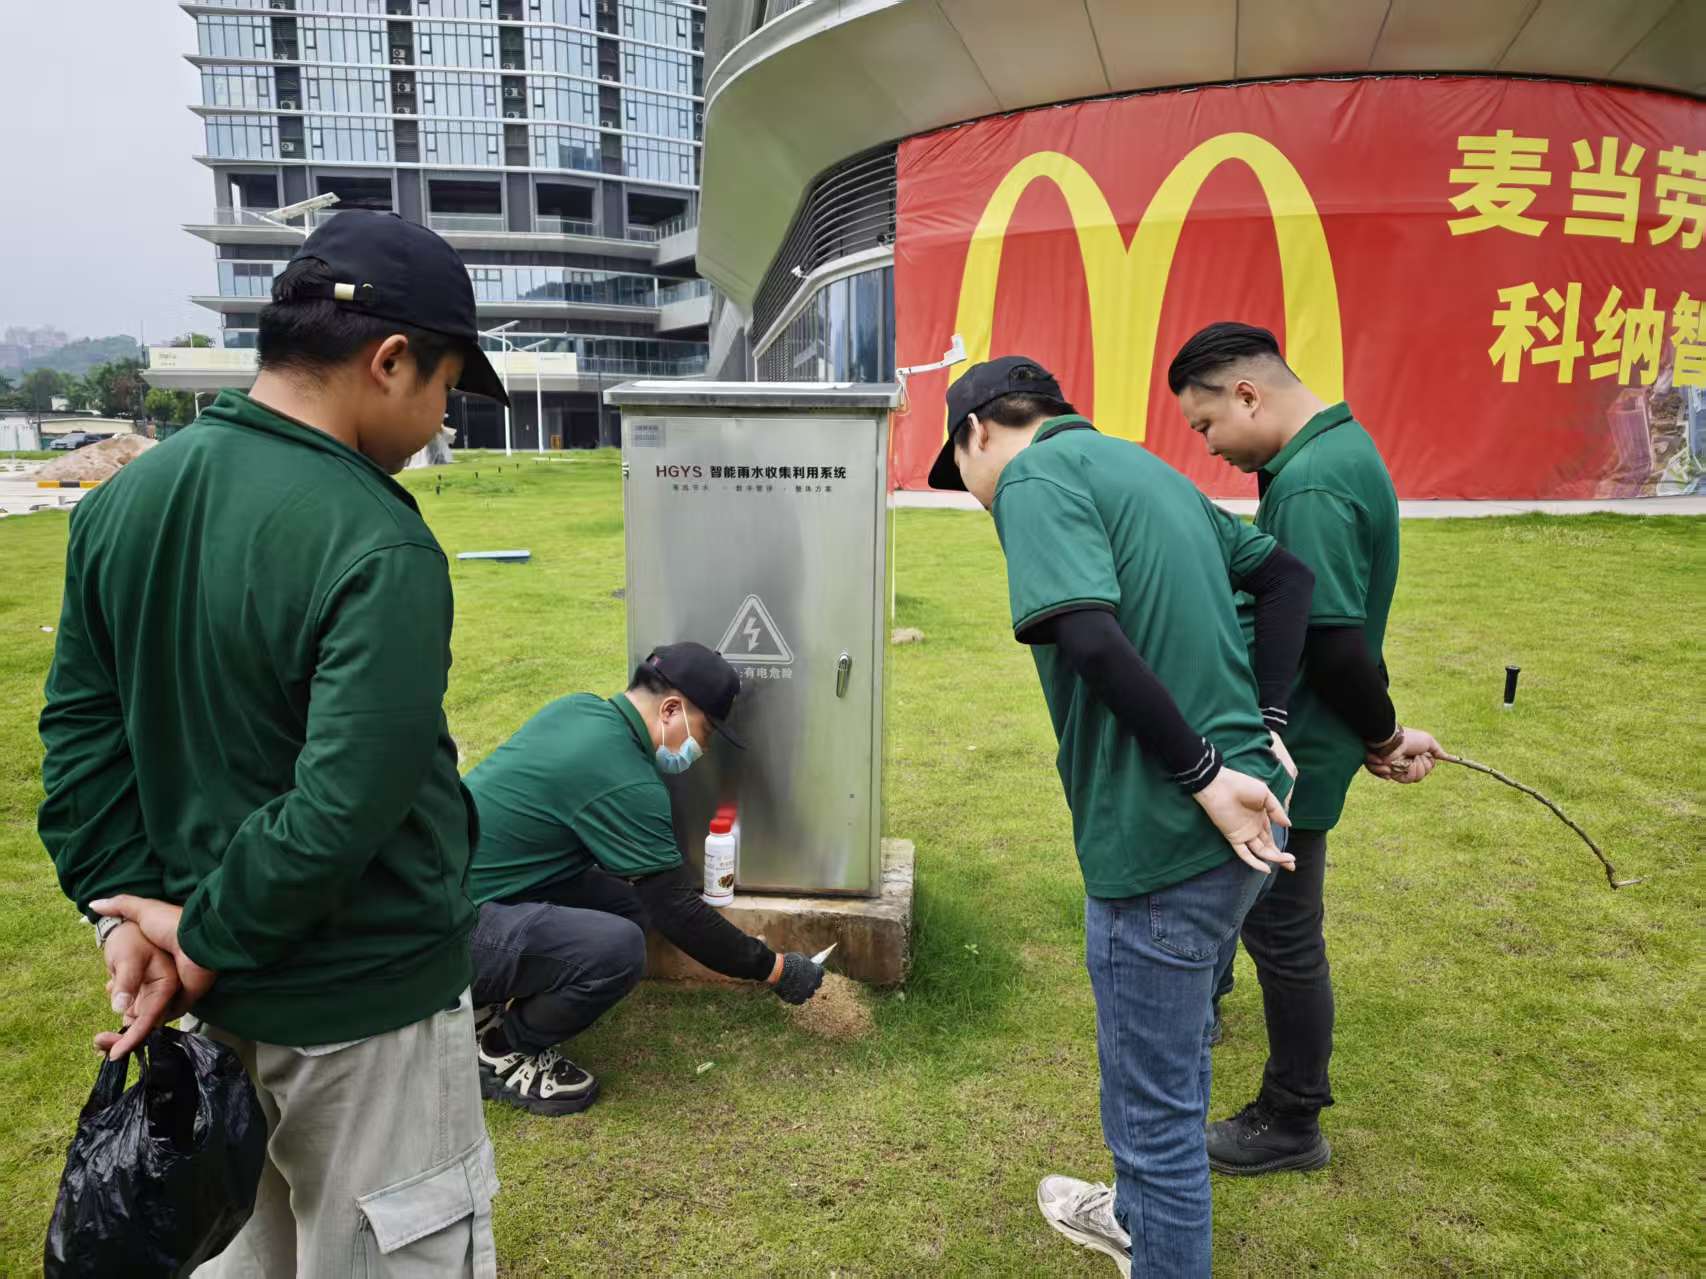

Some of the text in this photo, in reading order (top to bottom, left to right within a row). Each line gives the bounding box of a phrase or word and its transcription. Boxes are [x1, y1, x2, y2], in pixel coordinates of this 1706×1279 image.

[1447, 129, 1706, 249] 麦当劳
[656, 465, 847, 480] HGYS 智能雨水收集利用系统
